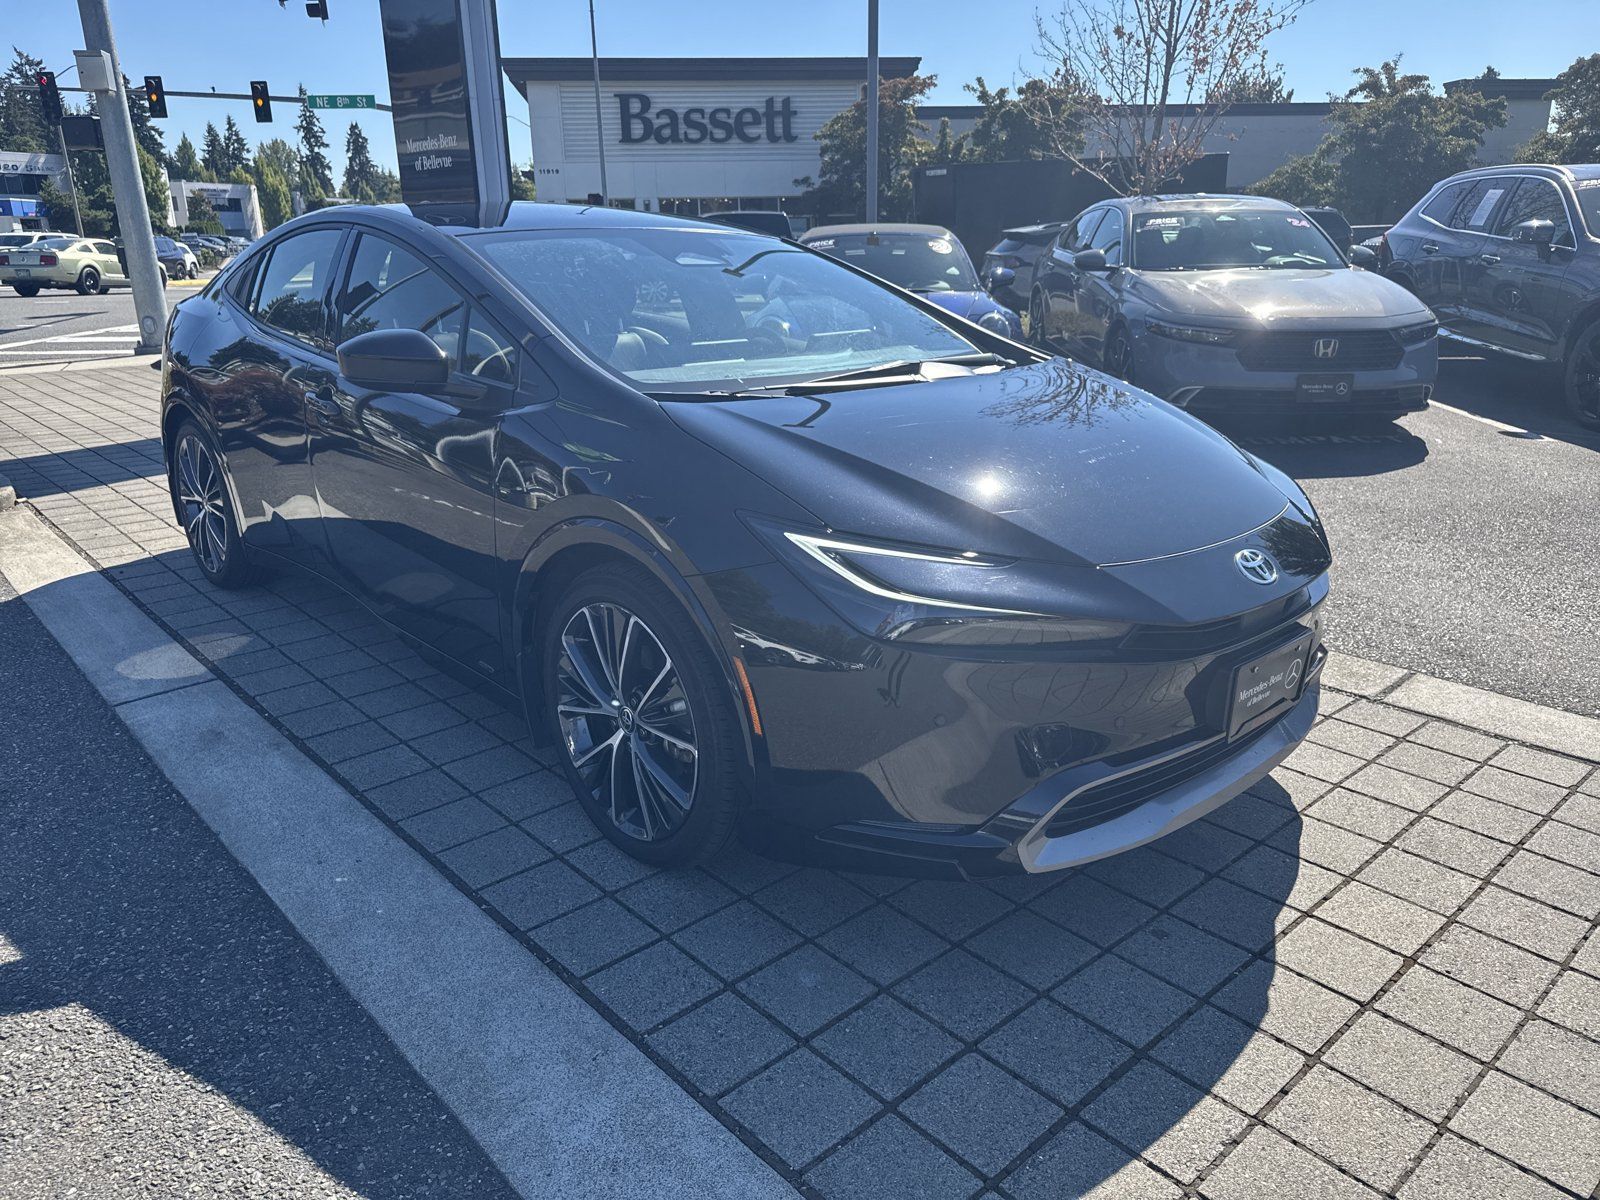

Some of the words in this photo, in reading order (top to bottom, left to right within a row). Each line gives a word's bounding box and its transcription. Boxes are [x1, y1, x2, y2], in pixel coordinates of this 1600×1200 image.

[316, 97, 330, 108] NE
[336, 96, 350, 108] 8th
[356, 97, 367, 108] St
[613, 93, 799, 144] Bassett
[406, 133, 457, 153] Mercedes-Benz
[414, 157, 422, 171] of
[423, 155, 453, 170] Bellevue
[1239, 672, 1284, 702] Mercedes-Benz
[1252, 690, 1271, 705] Bellevue
